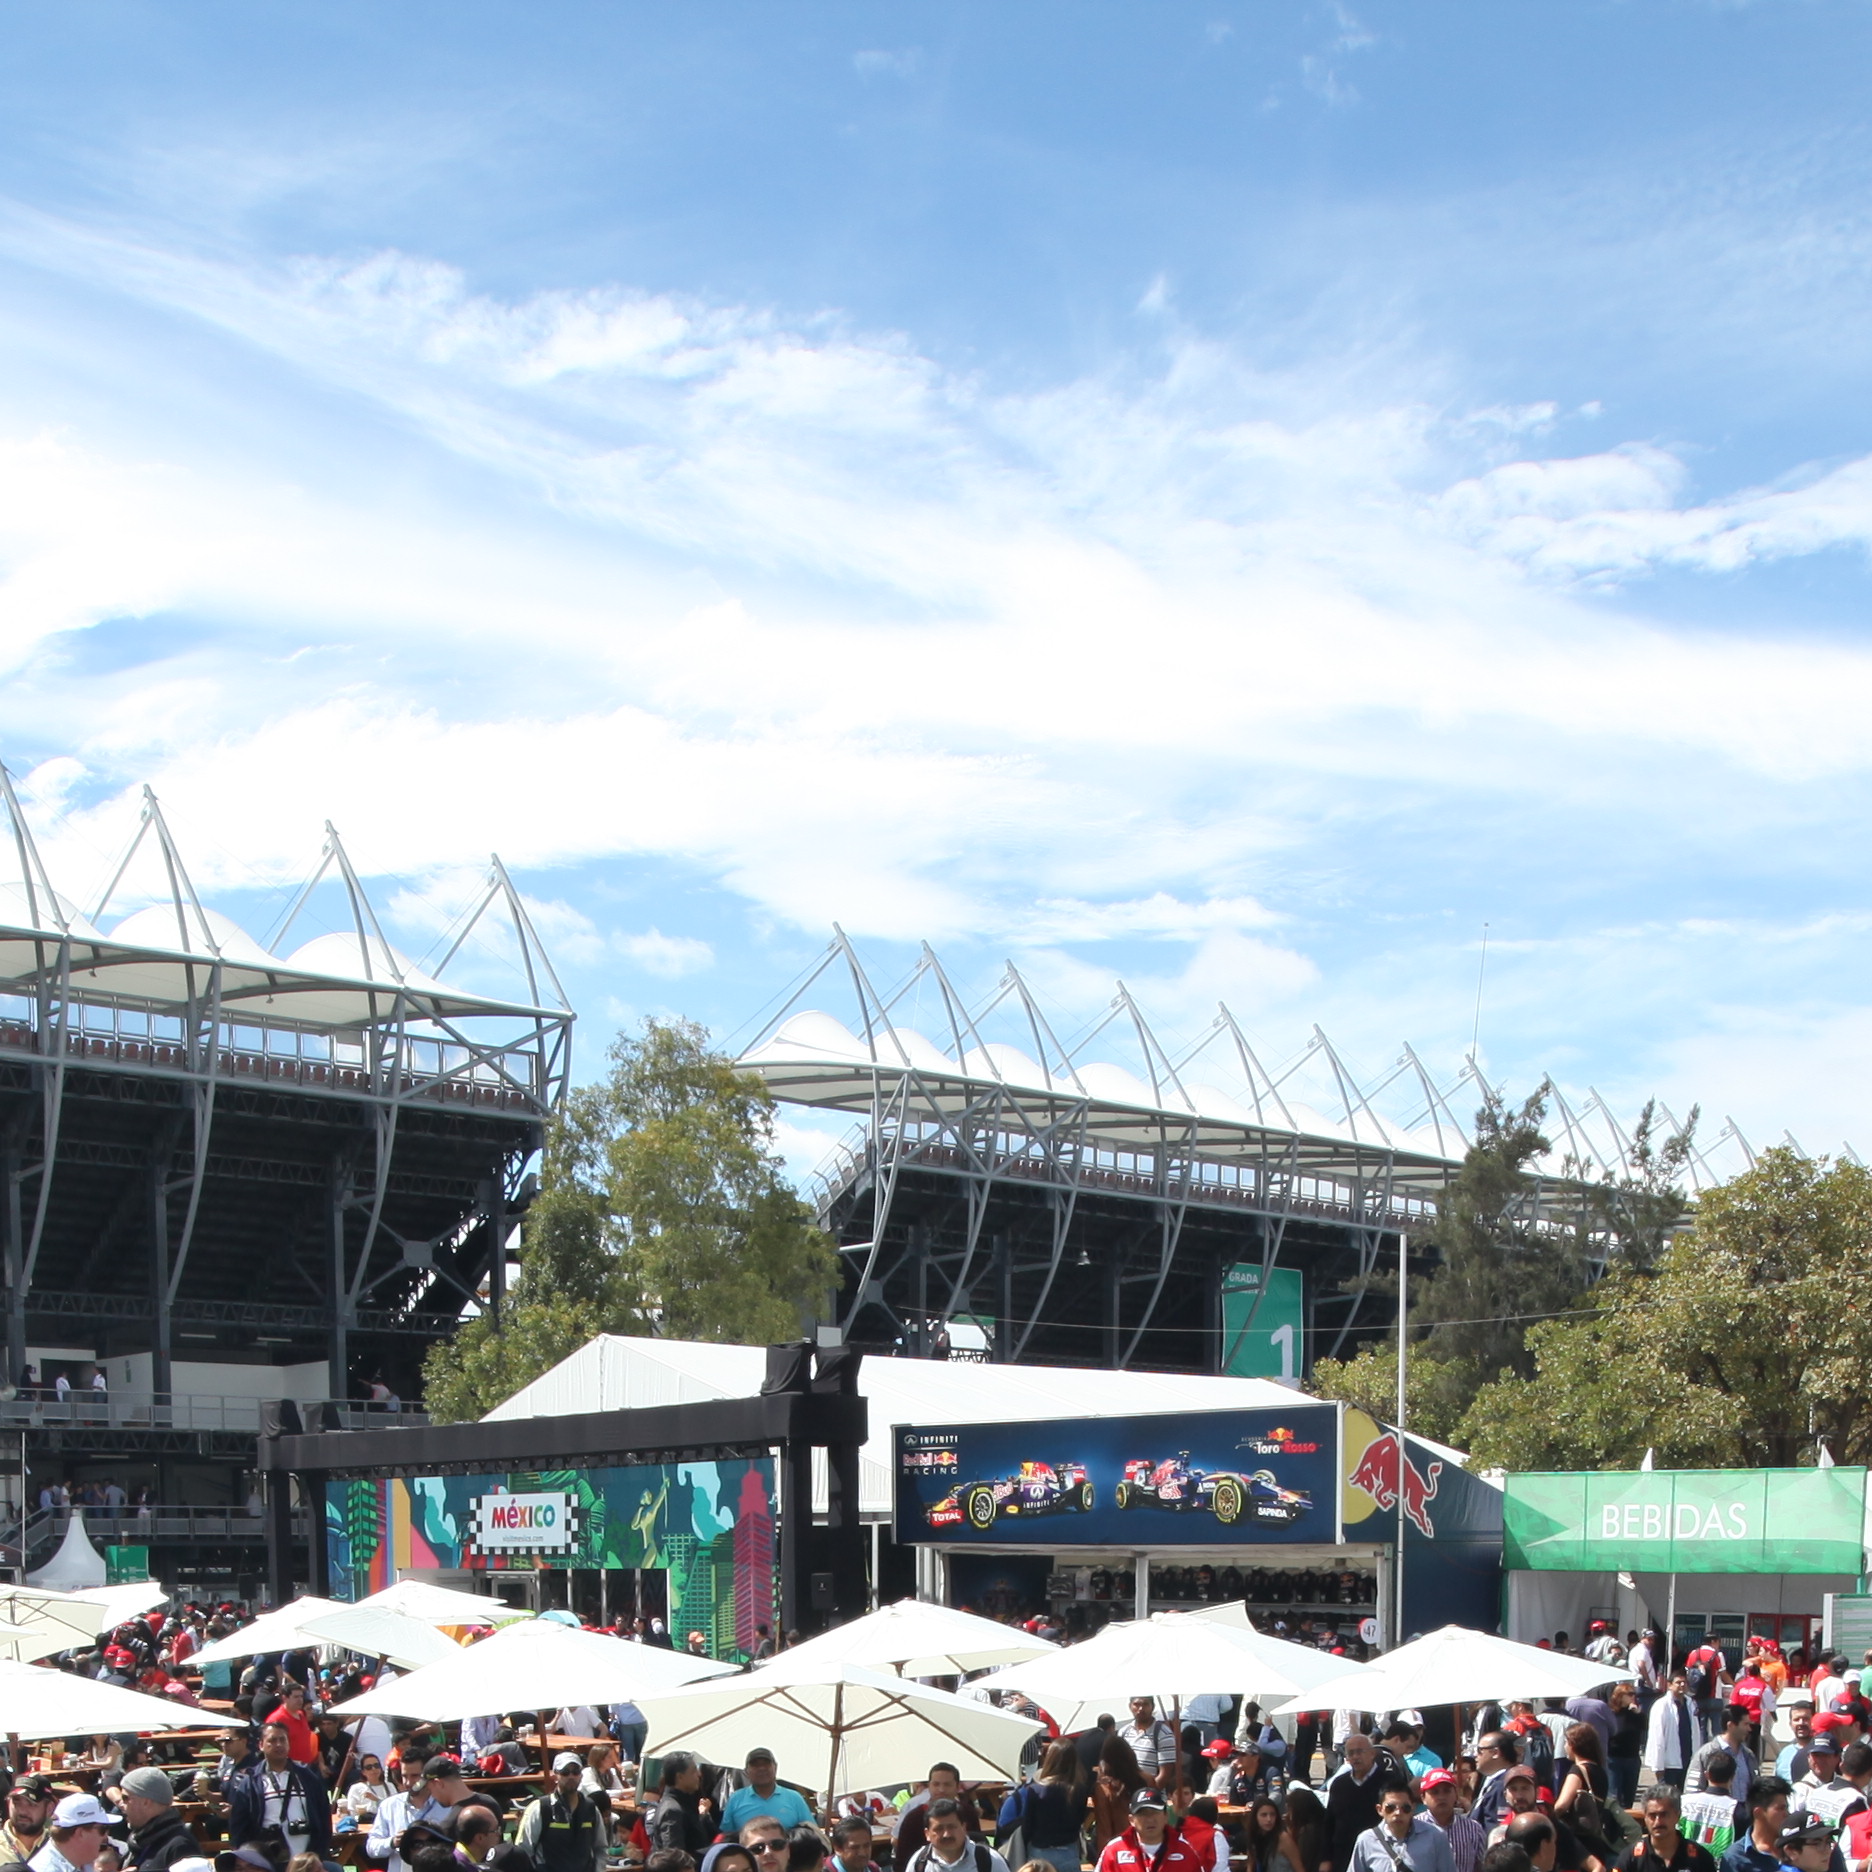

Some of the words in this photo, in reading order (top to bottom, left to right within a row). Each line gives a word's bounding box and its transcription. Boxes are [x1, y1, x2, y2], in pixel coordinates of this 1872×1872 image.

[1229, 1271, 1259, 1284] GRADA
[1271, 1324, 1299, 1389] 1
[919, 1435, 958, 1444] INFINITI
[1256, 1441, 1280, 1454] Toro
[1282, 1440, 1317, 1453] Rosso
[903, 1466, 958, 1475] RACING
[932, 1509, 961, 1522] TOTAL
[1601, 1502, 1748, 1540] BEBIDAS
[1364, 1625, 1376, 1637] 47
[1384, 1757, 1393, 1771] 2
